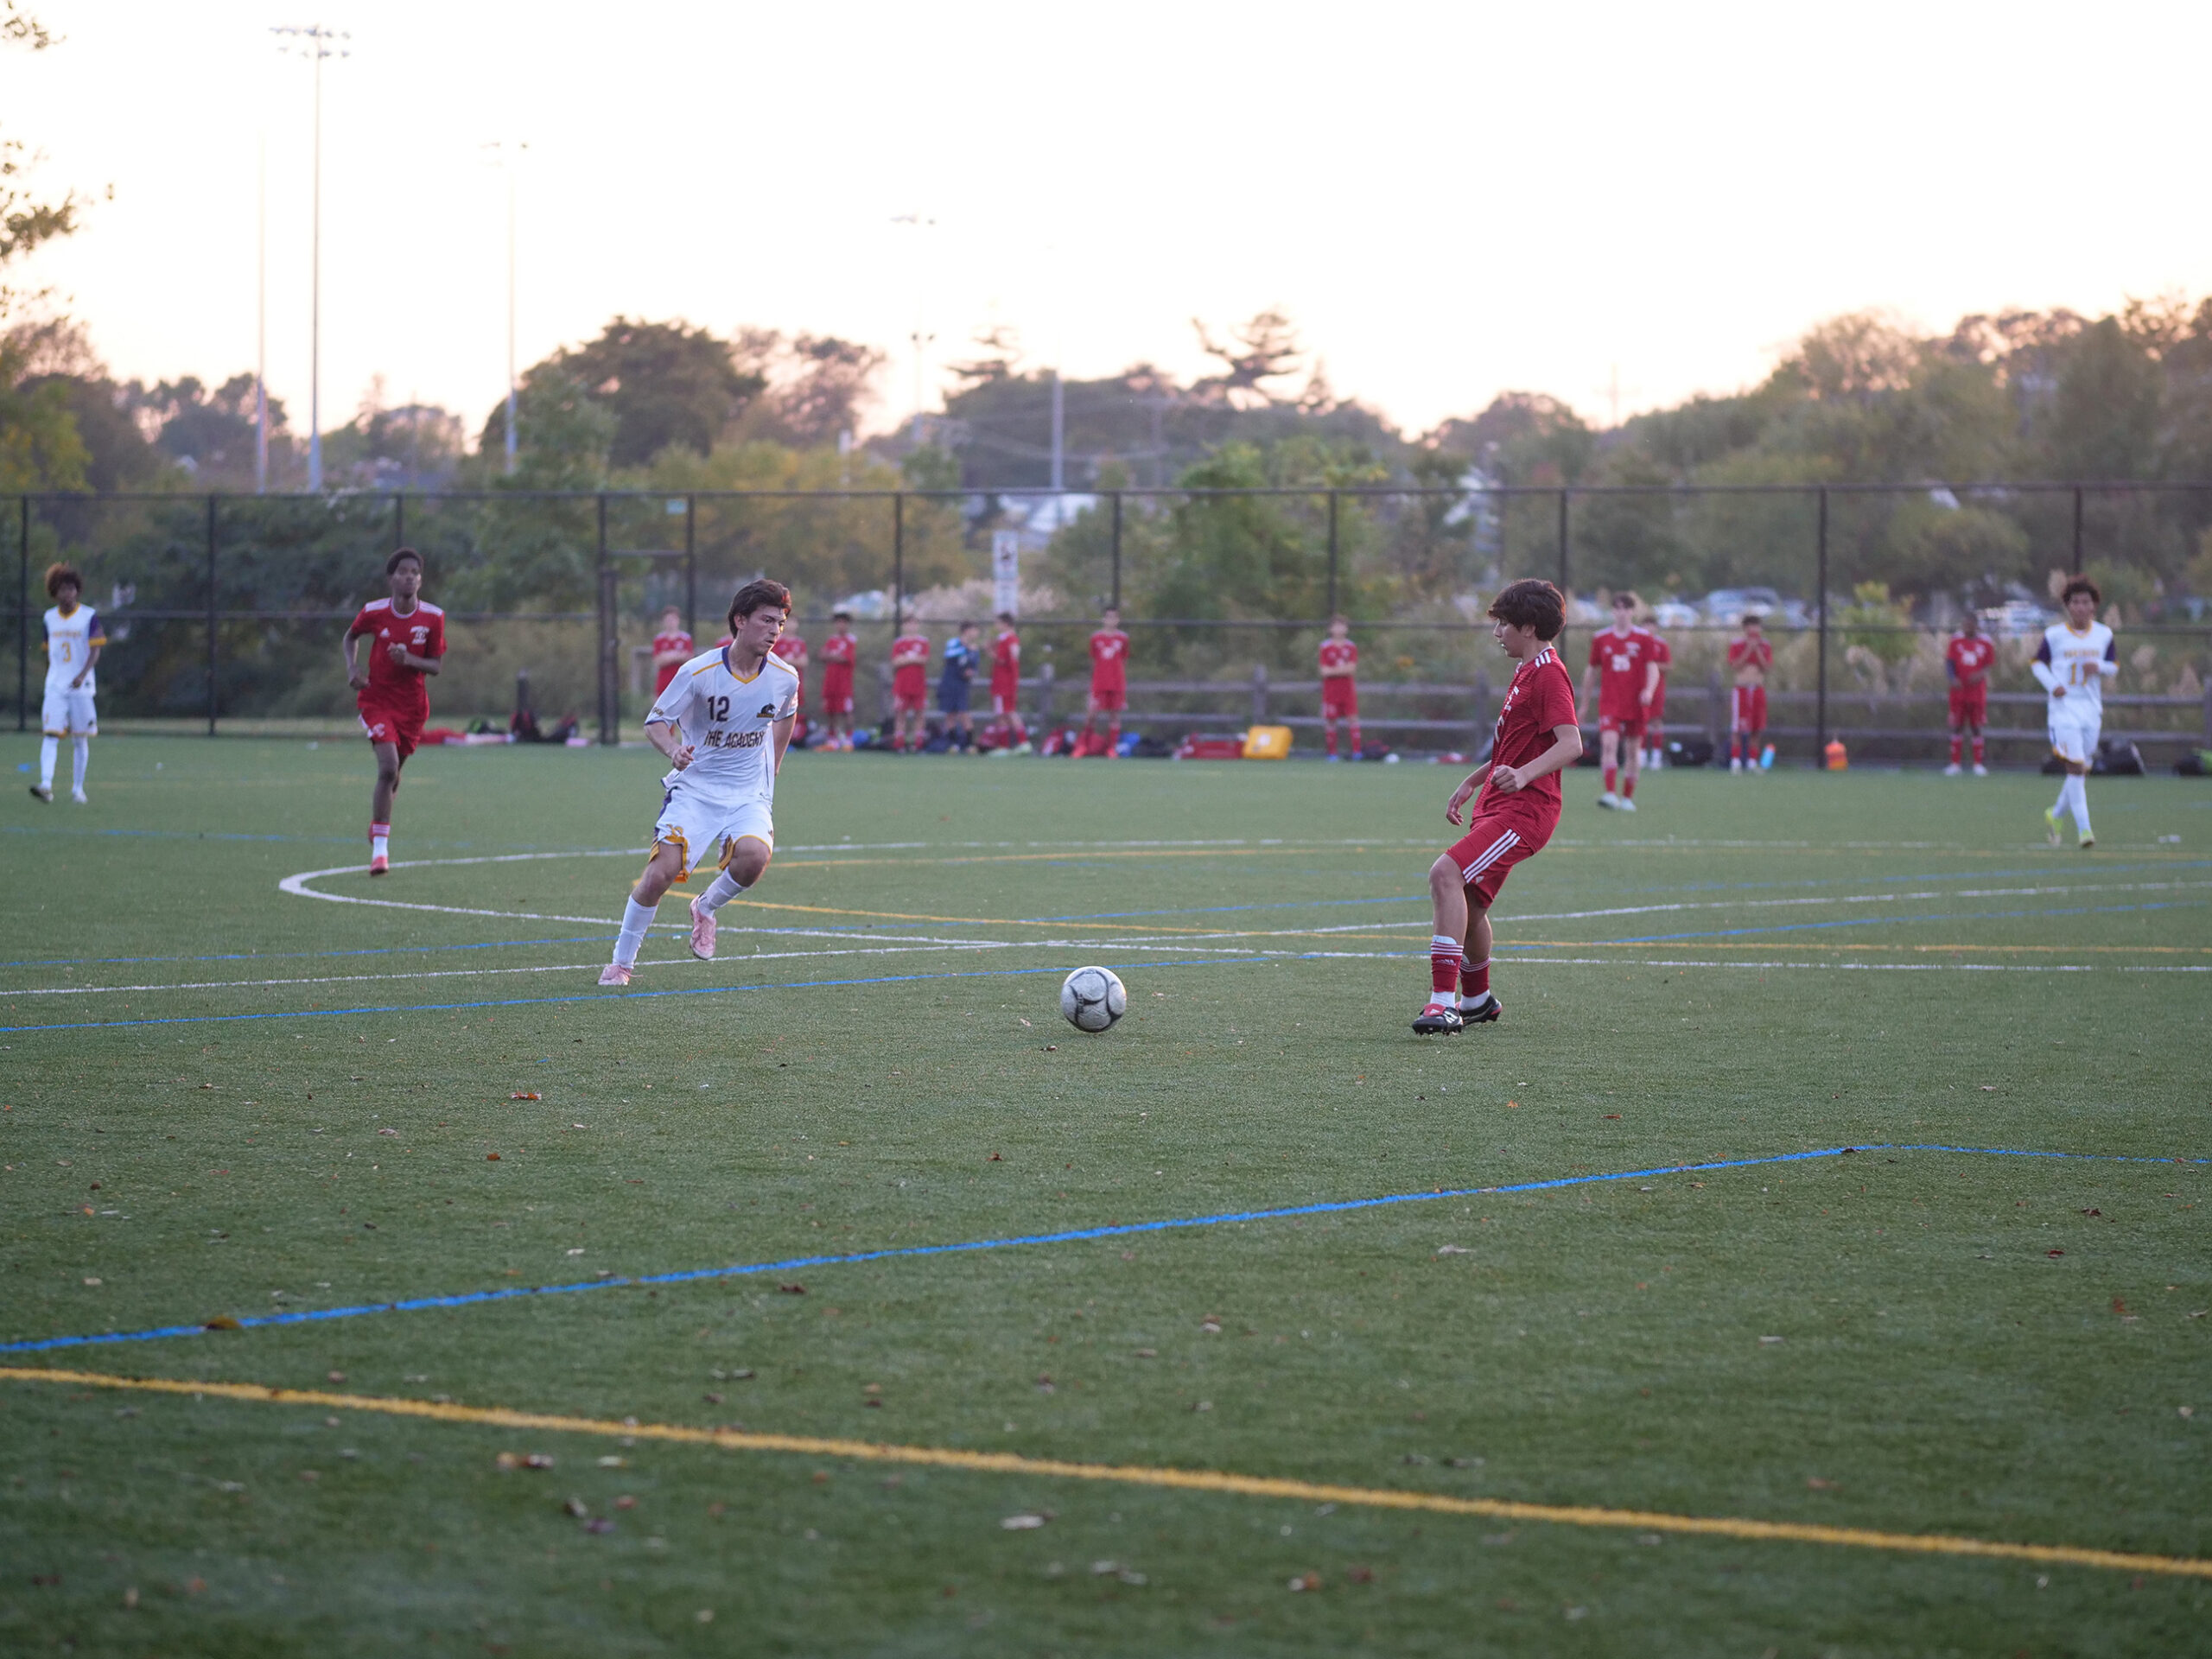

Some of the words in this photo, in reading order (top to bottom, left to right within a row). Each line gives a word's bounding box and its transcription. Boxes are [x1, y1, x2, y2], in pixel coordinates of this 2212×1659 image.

[61, 642, 72, 662] 3
[707, 696, 730, 722] 12
[703, 729, 724, 747] THE
[724, 729, 766, 748] ACADEMY
